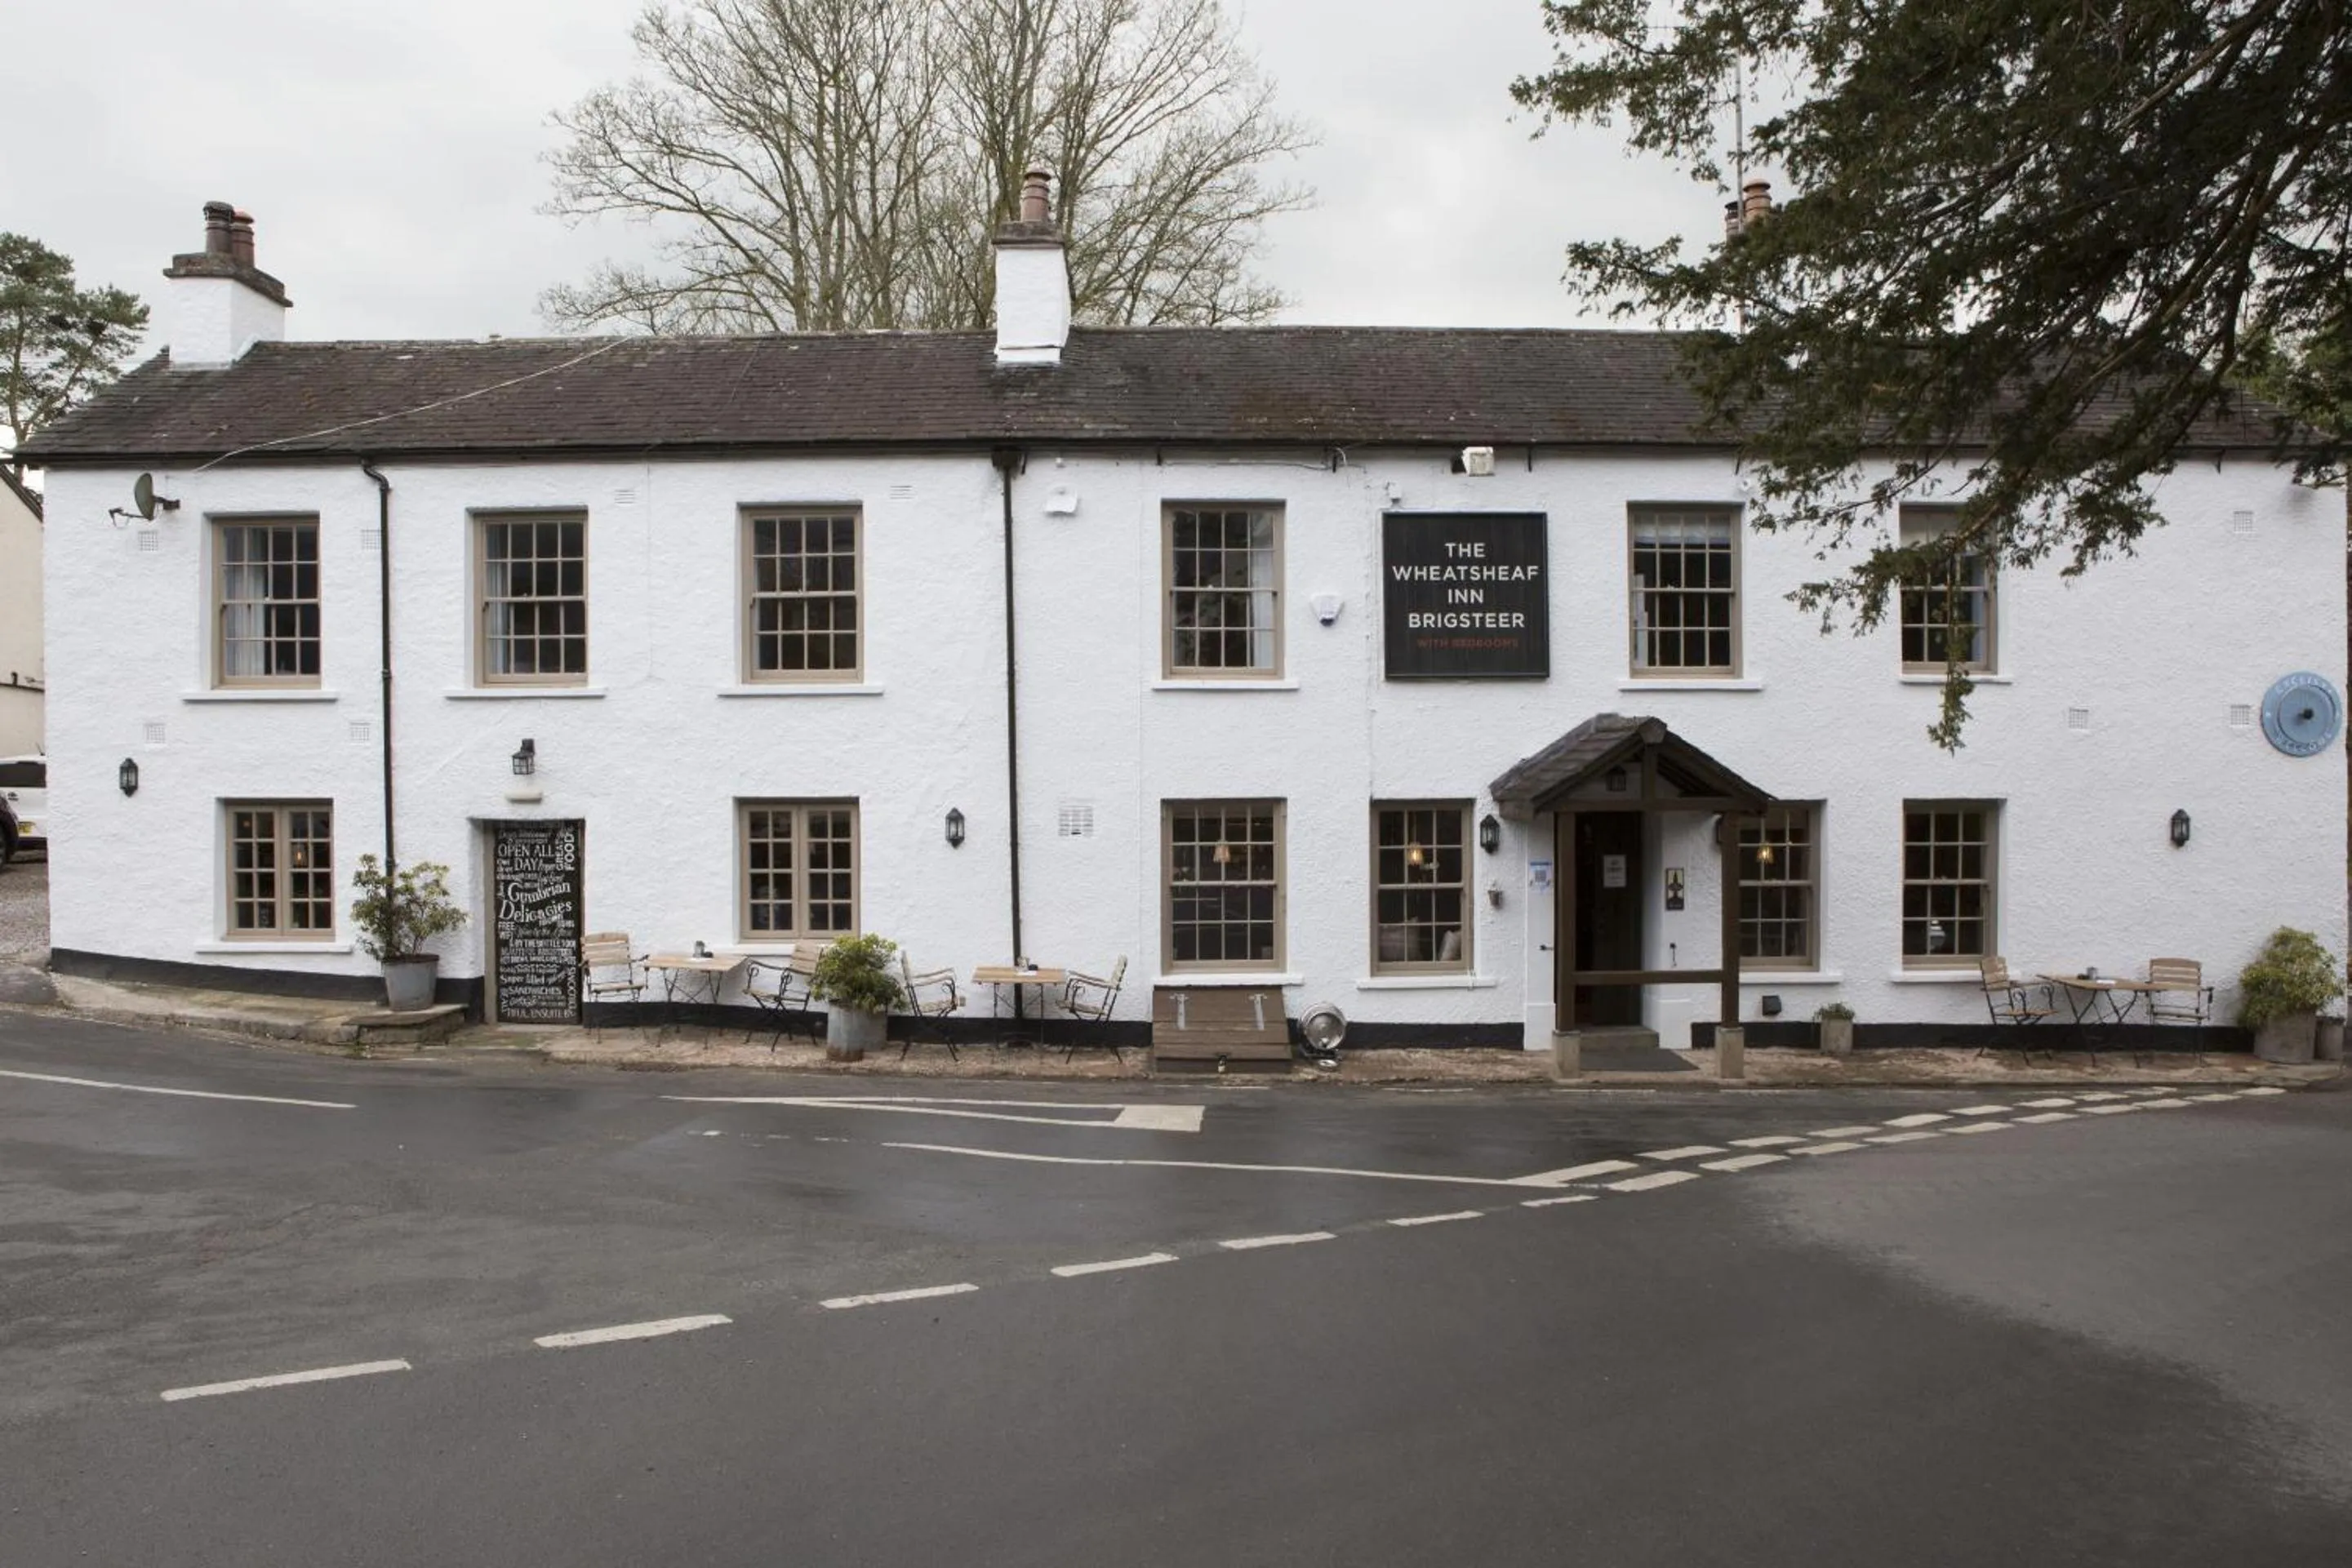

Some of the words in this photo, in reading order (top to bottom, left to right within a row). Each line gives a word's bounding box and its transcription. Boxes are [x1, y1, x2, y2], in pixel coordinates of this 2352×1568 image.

[1445, 543, 1486, 557] THE
[1392, 566, 1539, 580] WHEATSHEAF
[1448, 589, 1484, 603] INN
[1408, 613, 1525, 628] BRIGSTEER
[1417, 638, 1448, 648] WITH
[1452, 638, 1518, 648] BEDROOMS
[498, 843, 530, 857] OPEN
[534, 844, 555, 857] ALL
[564, 832, 575, 871] FOOD
[508, 882, 571, 904] Cumbrian
[498, 921, 515, 931] FREE
